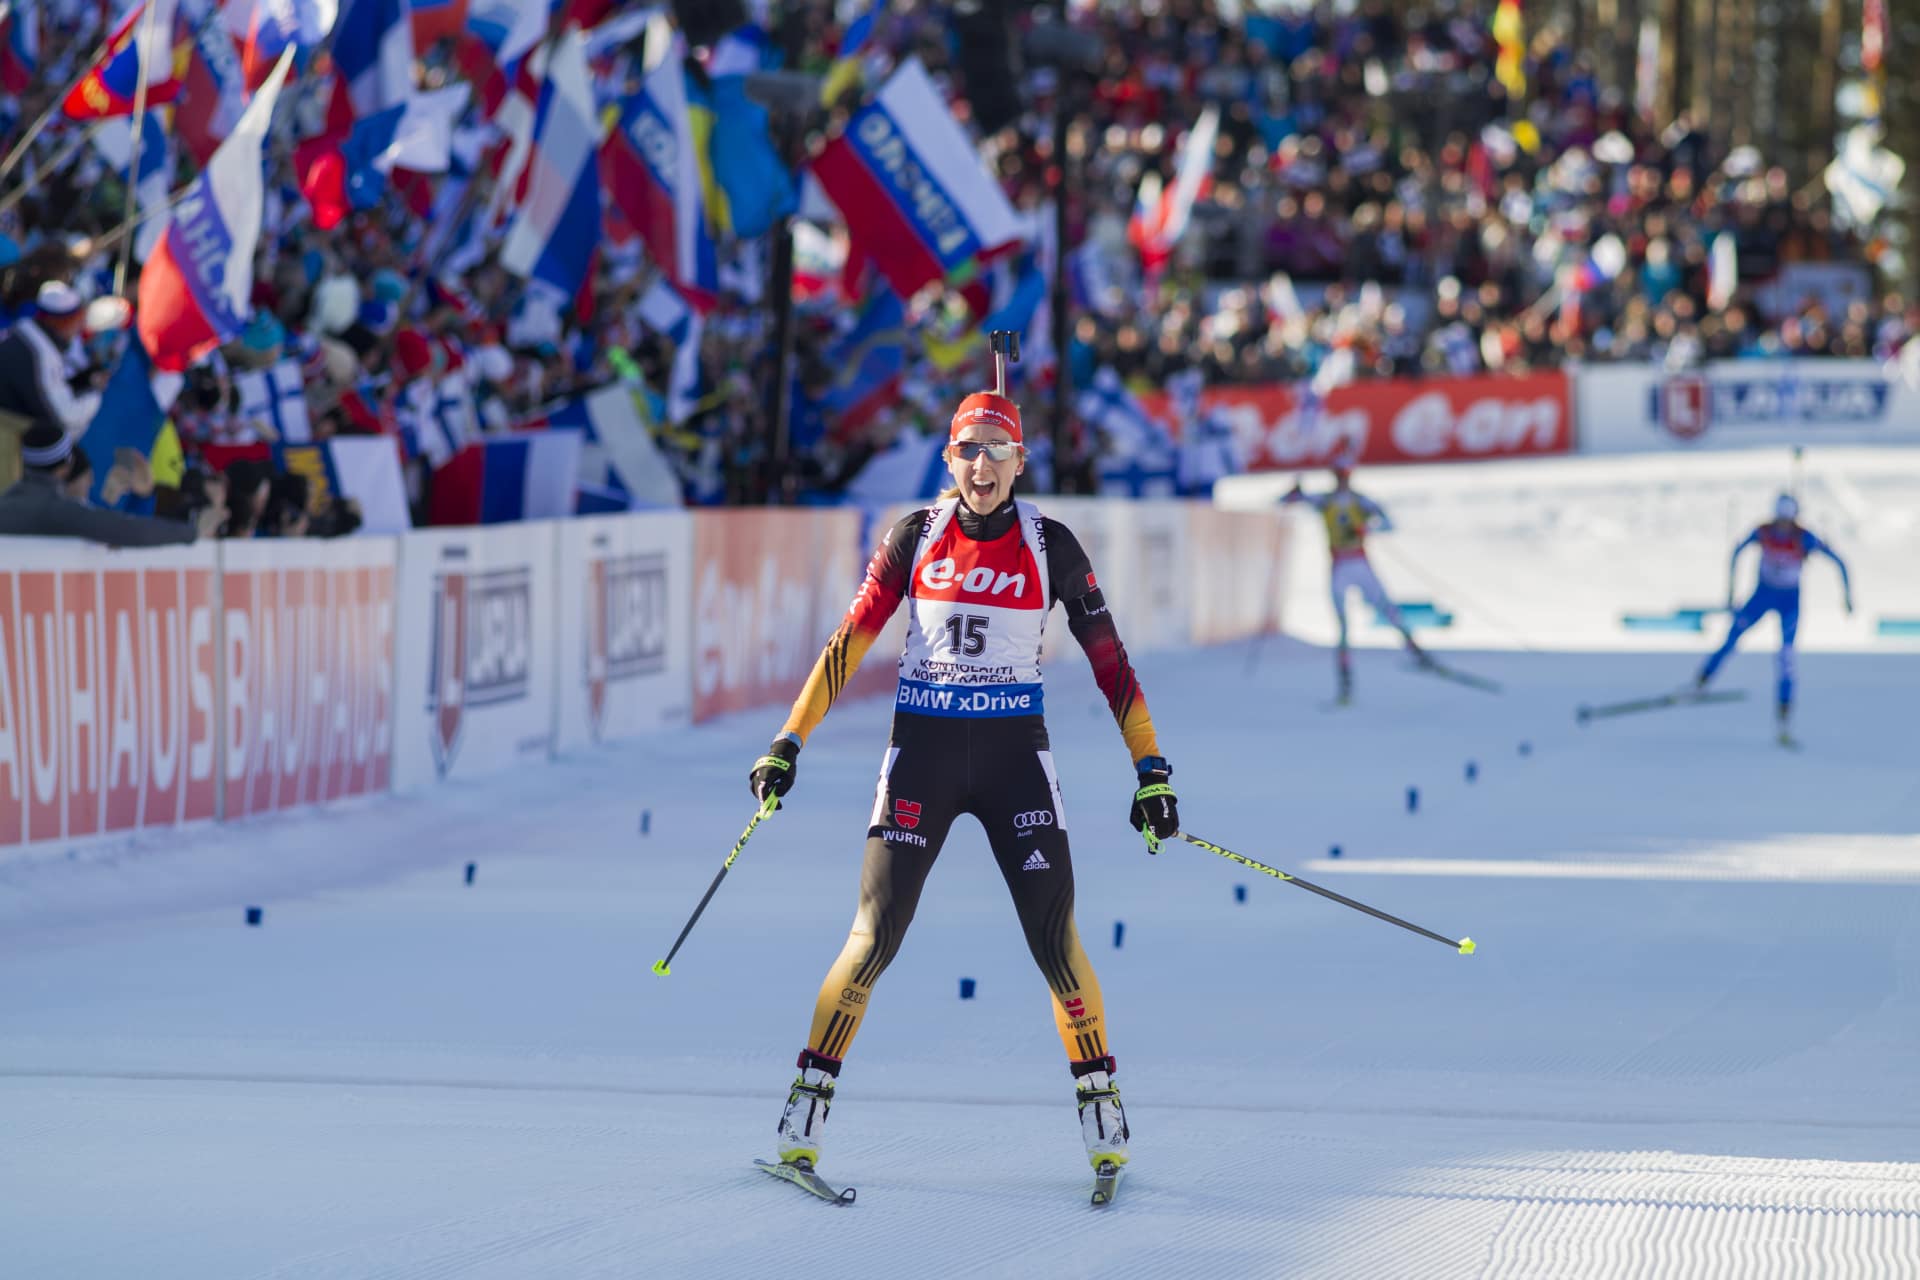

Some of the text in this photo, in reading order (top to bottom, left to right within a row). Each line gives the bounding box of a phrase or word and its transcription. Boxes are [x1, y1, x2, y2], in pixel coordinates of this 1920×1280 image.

[920, 508, 943, 539] JOKA
[945, 613, 989, 657] 15
[911, 668, 956, 682] NORTH
[898, 685, 1031, 711] BMW xDrive
[1017, 829, 1033, 838] Audi
[1022, 861, 1050, 871] adidas
